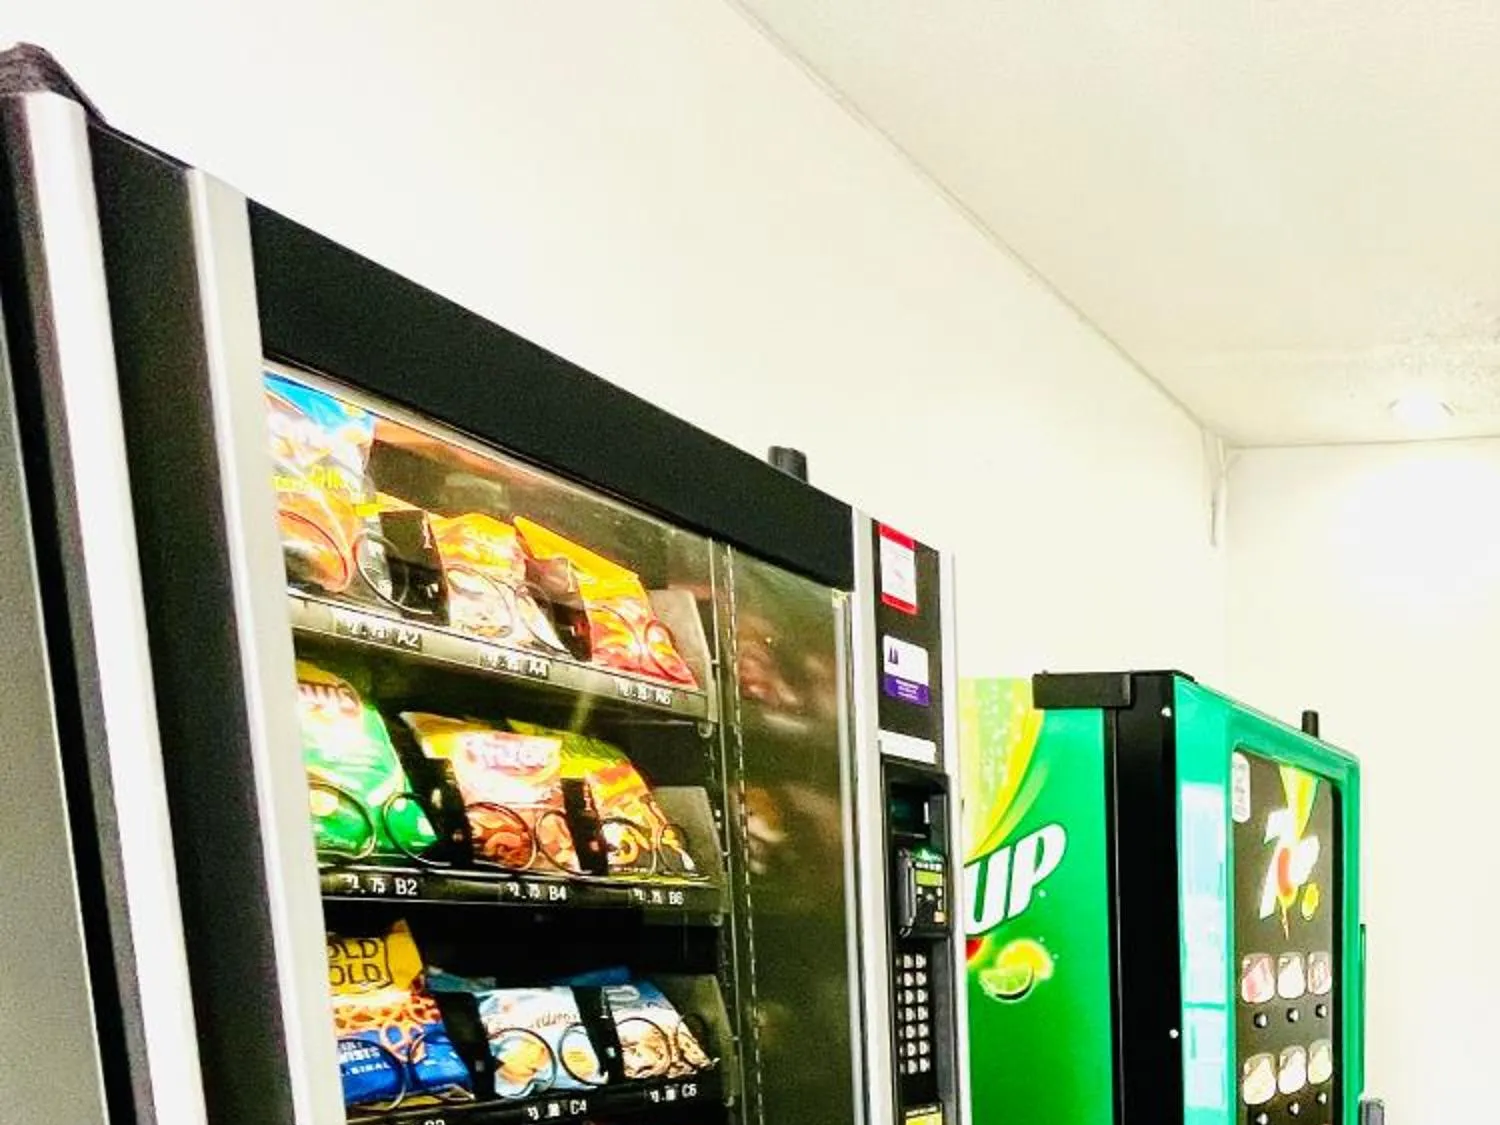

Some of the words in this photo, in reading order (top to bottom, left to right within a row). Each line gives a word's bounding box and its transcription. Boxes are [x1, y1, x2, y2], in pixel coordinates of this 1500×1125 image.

[395, 877, 418, 896] B2
[549, 885, 568, 901] B4
[681, 1083, 697, 1099] C6
[570, 1099, 588, 1116] C4
